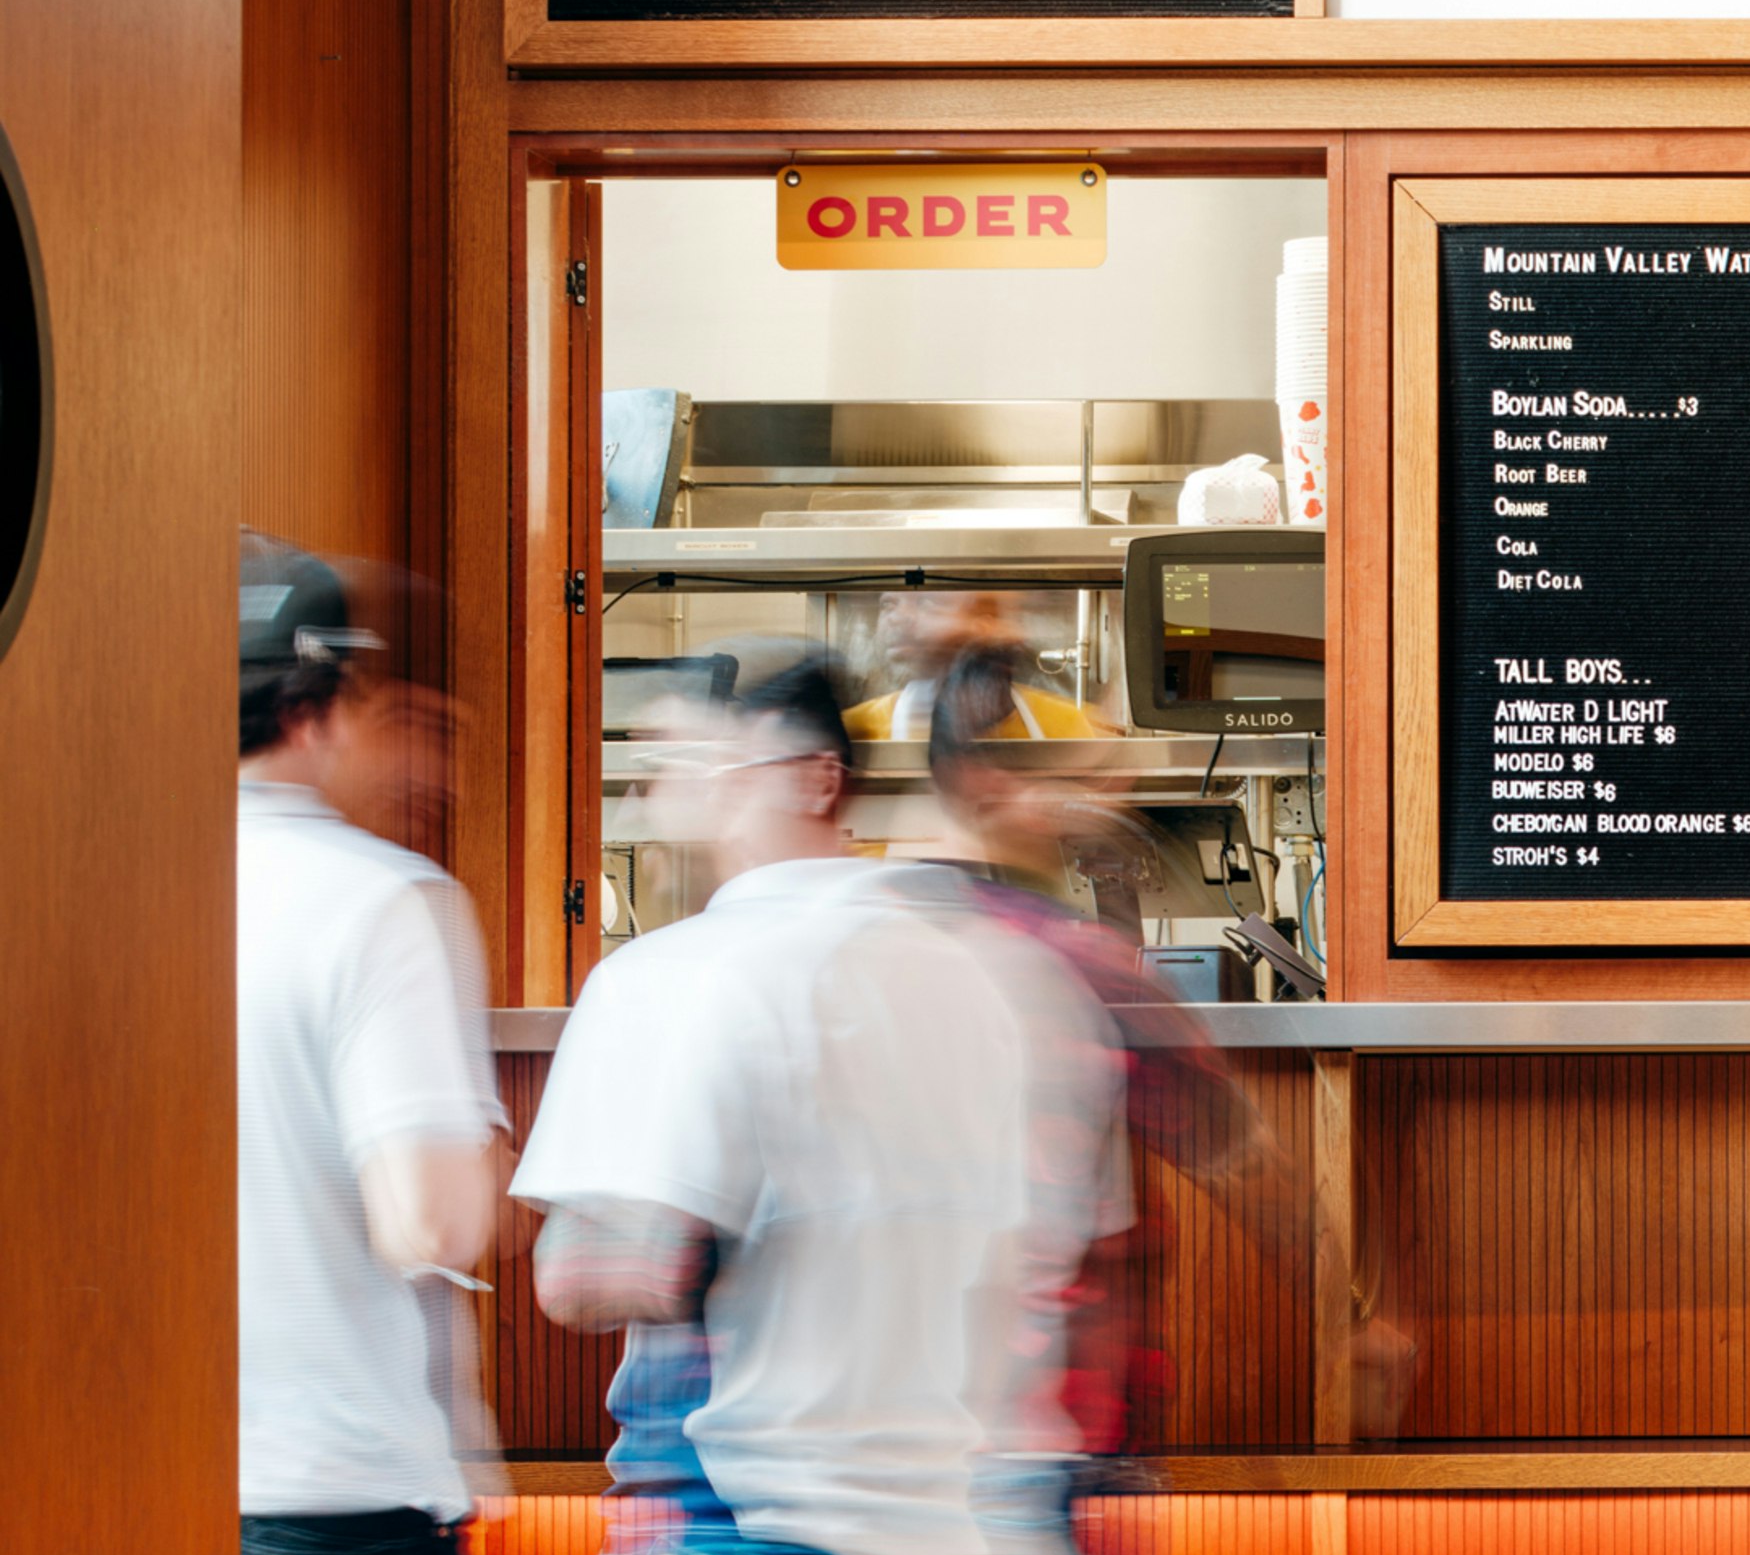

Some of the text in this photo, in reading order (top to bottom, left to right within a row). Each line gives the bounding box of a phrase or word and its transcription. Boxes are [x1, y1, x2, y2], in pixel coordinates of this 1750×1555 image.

[806, 195, 1073, 239] ORDER
[1678, 396, 1699, 416] $3
[1494, 659, 1553, 684] TALL
[1584, 700, 1599, 722] D
[1608, 699, 1668, 723] LIGHT
[1494, 725, 1675, 744] MILLER HIGH LIFE $6
[1494, 753, 1594, 772] MODELO $6
[1492, 780, 1616, 802] BUDWEISER $6
[1492, 814, 1587, 833] CHEBOYGAN
[1597, 814, 1651, 833] BLOOD
[1654, 814, 1726, 833] ORANGE
[1492, 845, 1600, 866] STROH'S $4
